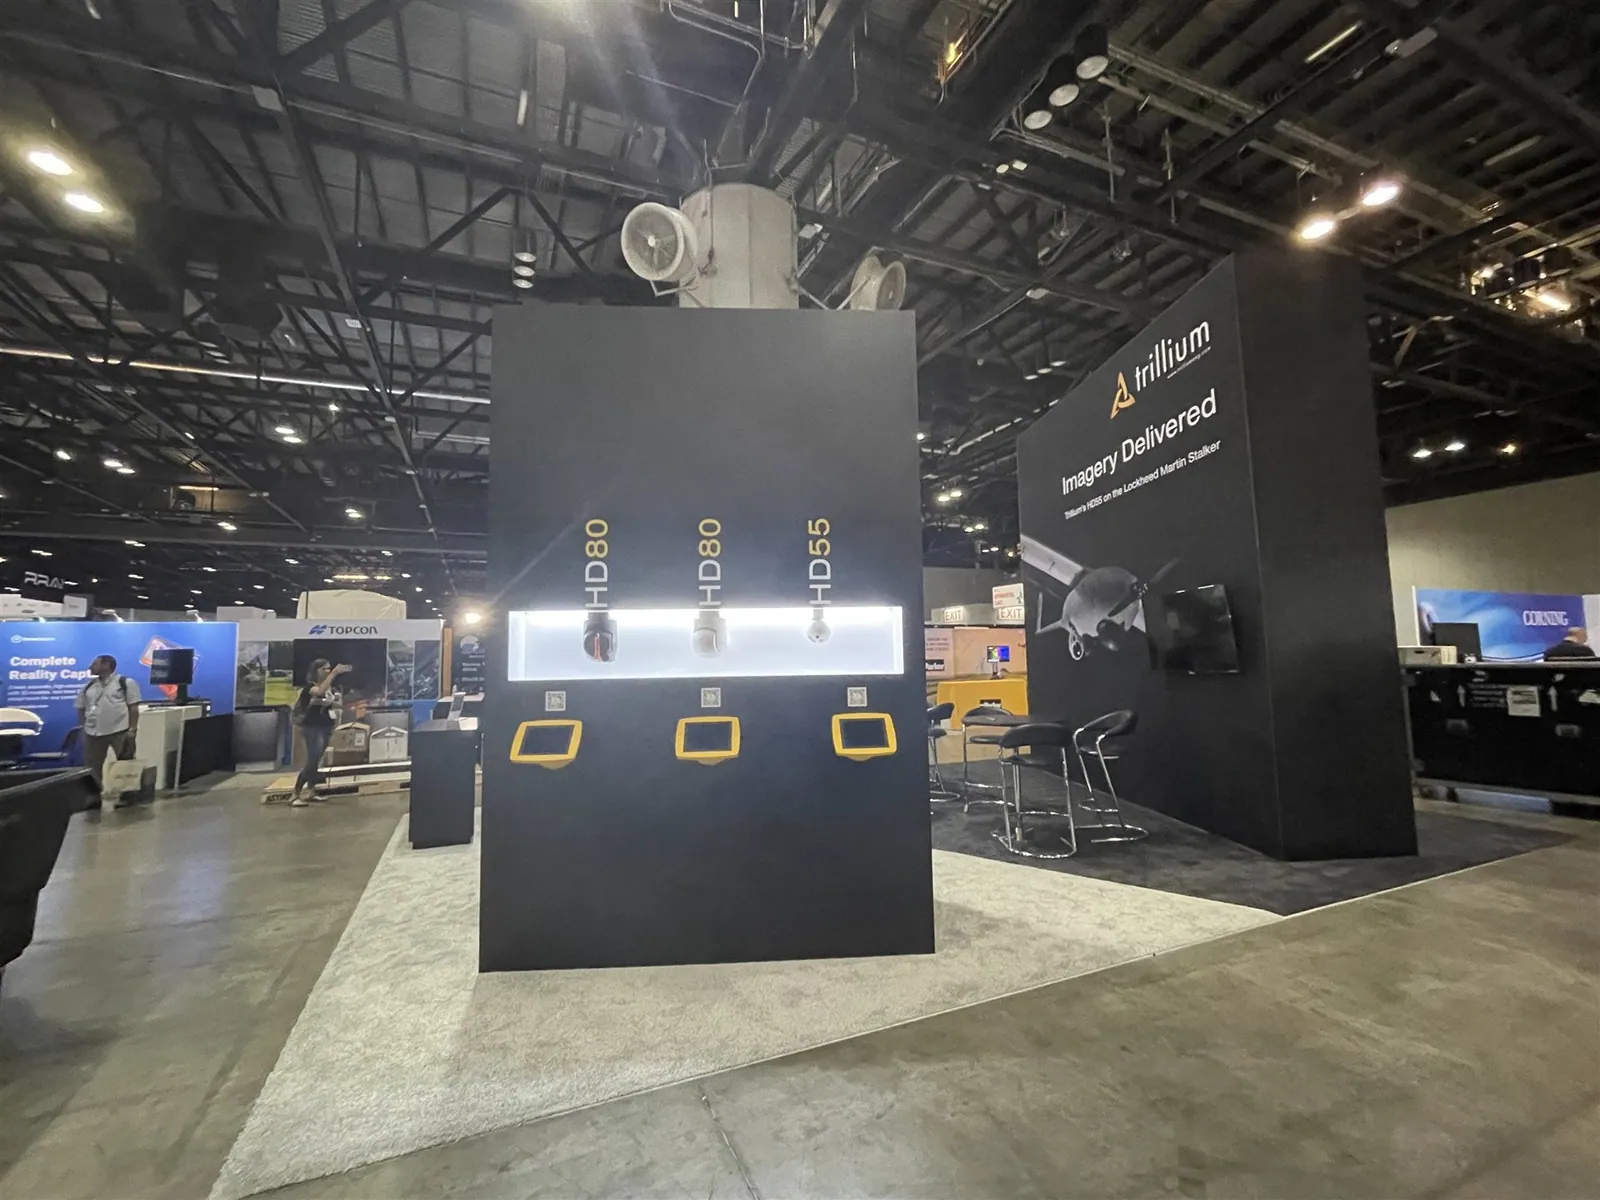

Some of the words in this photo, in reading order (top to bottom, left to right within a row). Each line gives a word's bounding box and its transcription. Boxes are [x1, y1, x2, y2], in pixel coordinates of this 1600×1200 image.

[1135, 321, 1210, 391] trillium
[1062, 451, 1118, 495] Imagery
[1121, 387, 1217, 463] Delivered
[1103, 492, 1112, 503] on
[1112, 486, 1123, 499] the
[1123, 469, 1159, 493] Lockheed
[1160, 457, 1187, 477] Martin
[1187, 440, 1221, 463] Stalker
[585, 519, 608, 607] HD80
[698, 518, 721, 606] HD80
[808, 518, 831, 604] HD55
[328, 626, 378, 635] TOPCON
[945, 610, 961, 621] EXIT
[1001, 608, 1021, 618] EXIT
[1523, 610, 1569, 626] CORNING
[9, 670, 57, 681] Reality
[60, 669, 93, 680] Capt
[10, 656, 76, 667] Complete
